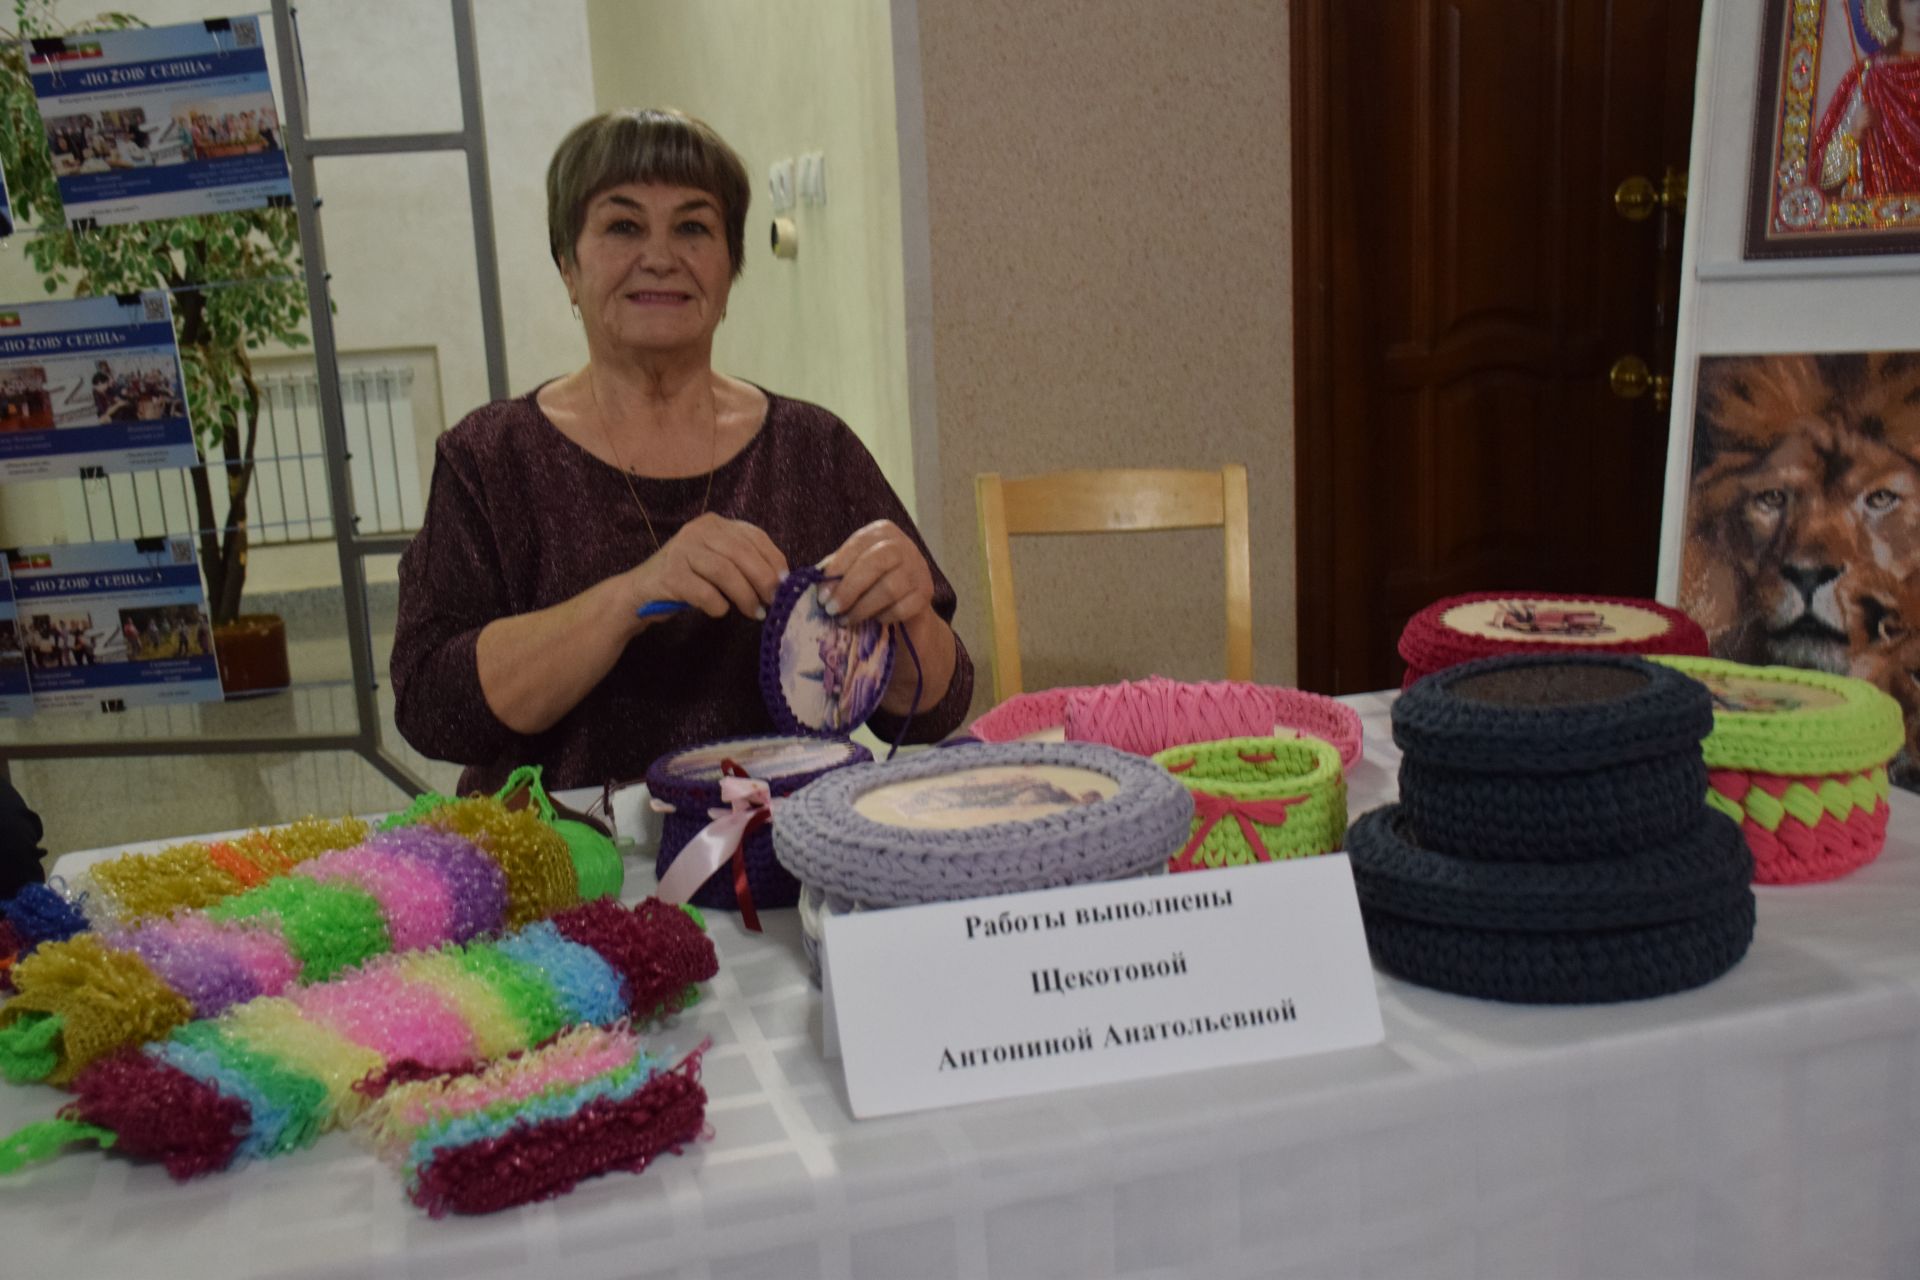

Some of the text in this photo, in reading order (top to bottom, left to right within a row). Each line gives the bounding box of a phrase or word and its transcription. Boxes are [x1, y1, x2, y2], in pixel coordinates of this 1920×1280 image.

[965, 888, 1234, 939] Работы выполнены
[1030, 951, 1188, 994] Щекотовой
[938, 999, 1298, 1070] Антониной Анатольевной
